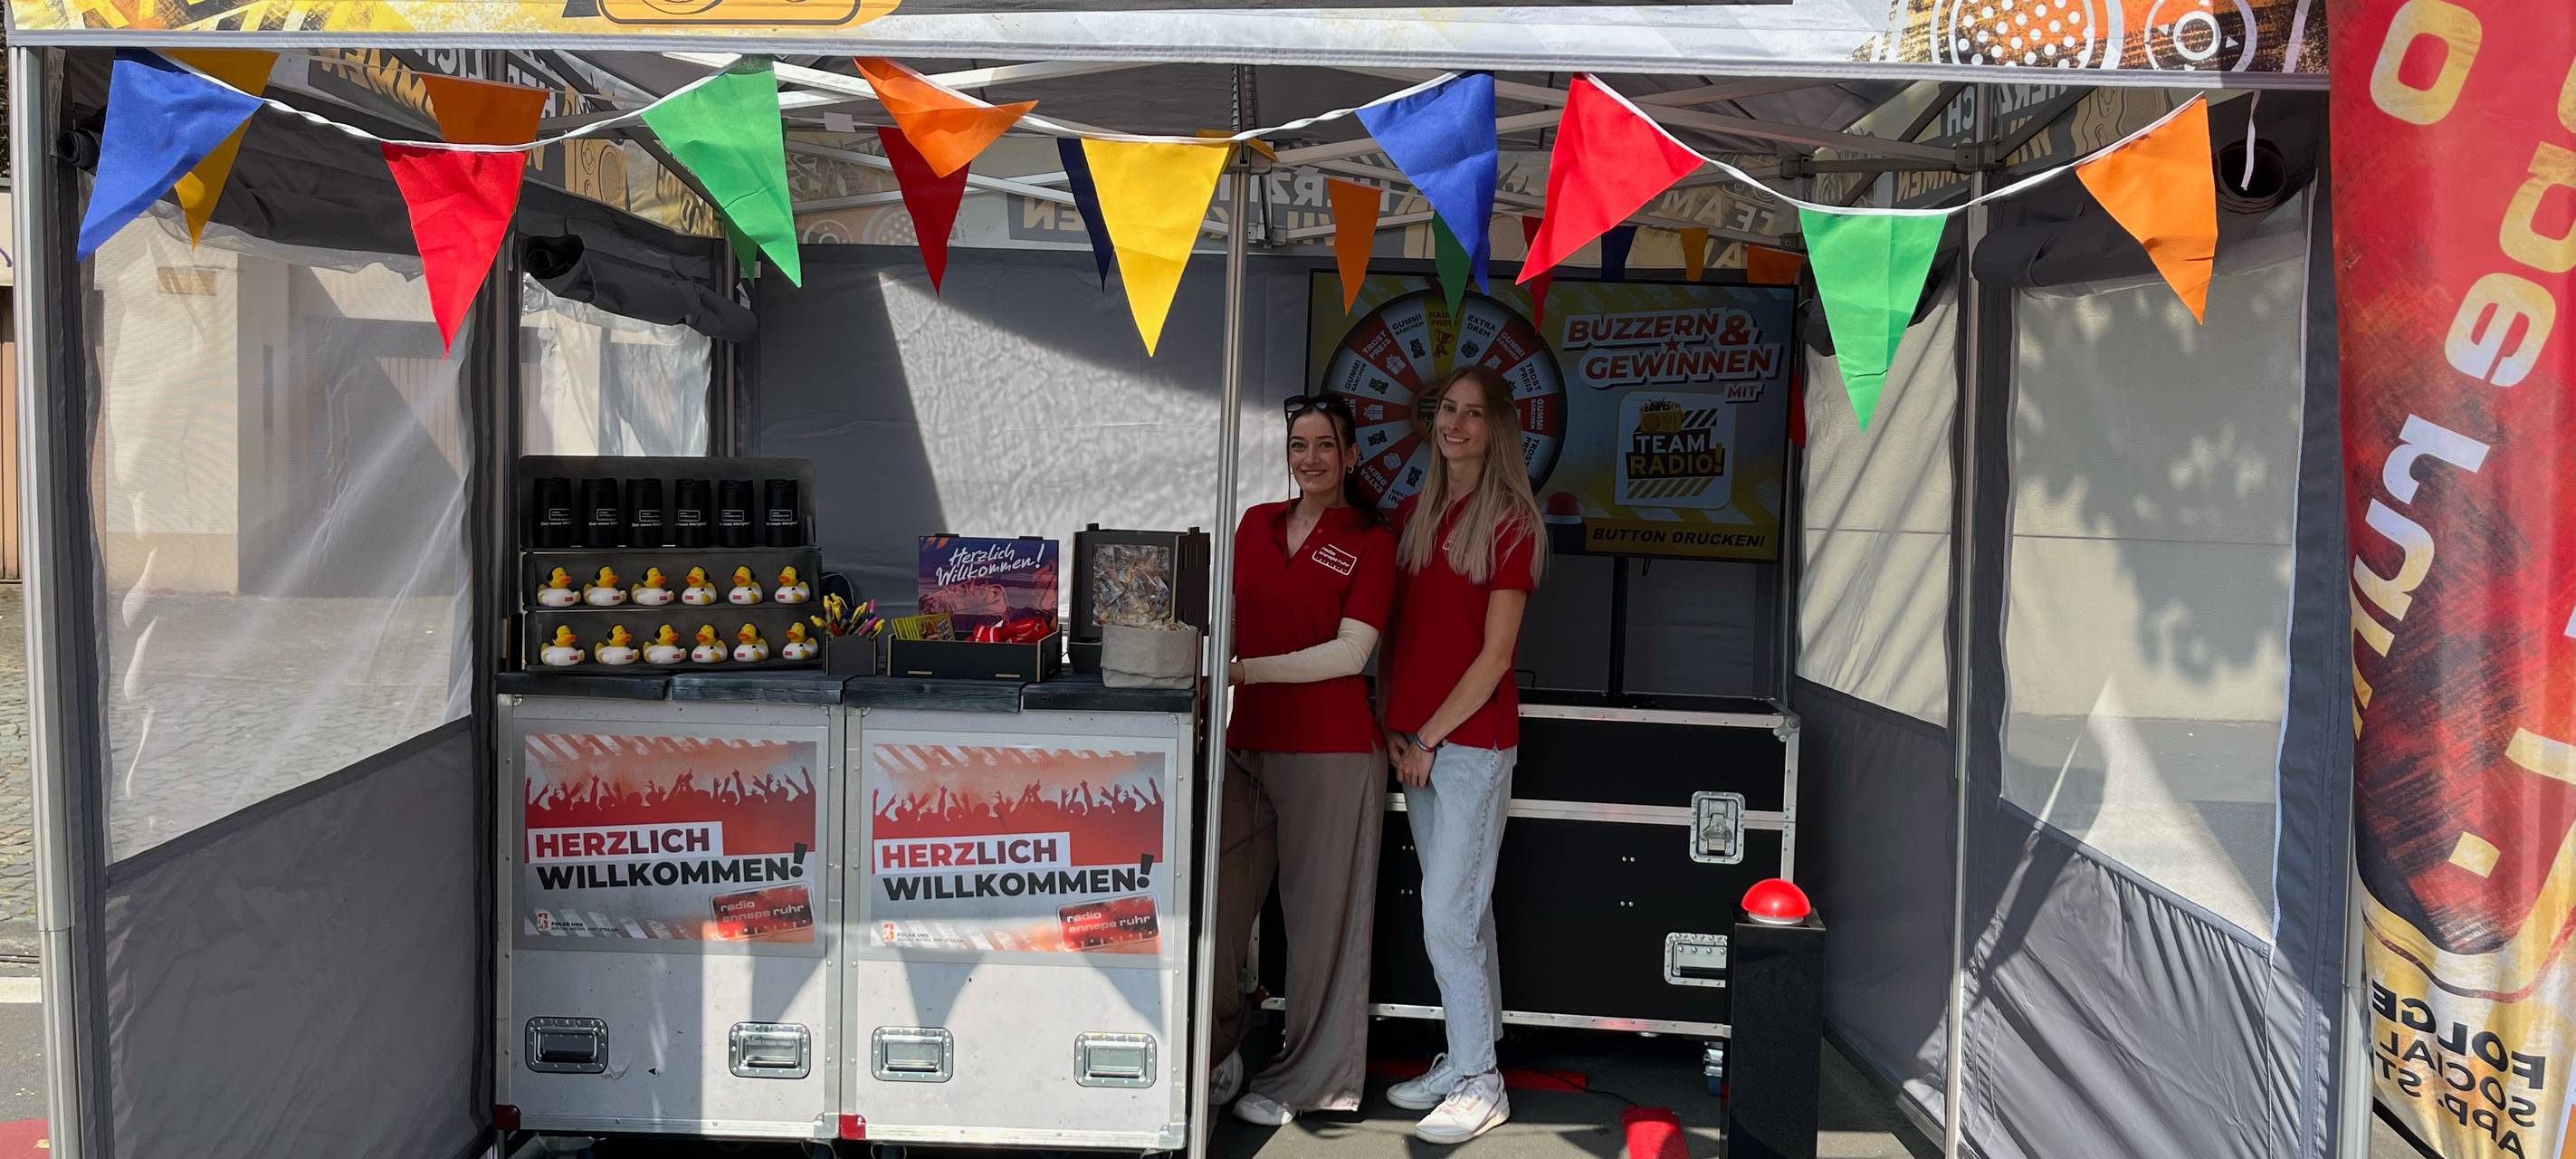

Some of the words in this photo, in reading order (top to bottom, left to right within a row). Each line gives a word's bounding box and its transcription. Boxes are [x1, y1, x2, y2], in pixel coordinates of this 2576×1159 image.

[1392, 313, 1422, 330] GUMMI
[1467, 322, 1491, 338] DREH
[1468, 314, 1495, 332] EXTRA
[1568, 313, 1719, 341] BUZZERN
[1361, 330, 1387, 354] TROST
[1368, 338, 1392, 360] PREIS
[1500, 331, 1527, 359] GUMMI
[1344, 359, 1362, 389] GUMMI
[1585, 347, 1771, 378] GEWINNEN
[1519, 367, 1533, 393] PREIS
[1526, 362, 1542, 391] TROST
[1727, 386, 1758, 398] MIT
[1537, 398, 1545, 430] GUMMI
[1636, 434, 1706, 453] TEAM
[1628, 442, 1723, 476] RADIO!
[1592, 527, 1667, 543] BUTTON
[1672, 529, 1766, 548] DRÜCKEN!
[936, 542, 1045, 587] Willkommen!
[949, 542, 1016, 568] Herzlich
[535, 828, 710, 857] HERZLICH
[883, 838, 1057, 869] HERZLICH
[536, 842, 808, 890] WILLKOMMEN!
[883, 852, 1155, 901] WILLKOMMEN!
[720, 900, 755, 913] radio
[772, 903, 805, 916] ruhr
[1067, 910, 1102, 923] radio
[1068, 919, 1117, 934] ennepe
[1119, 915, 1151, 927] ruhr
